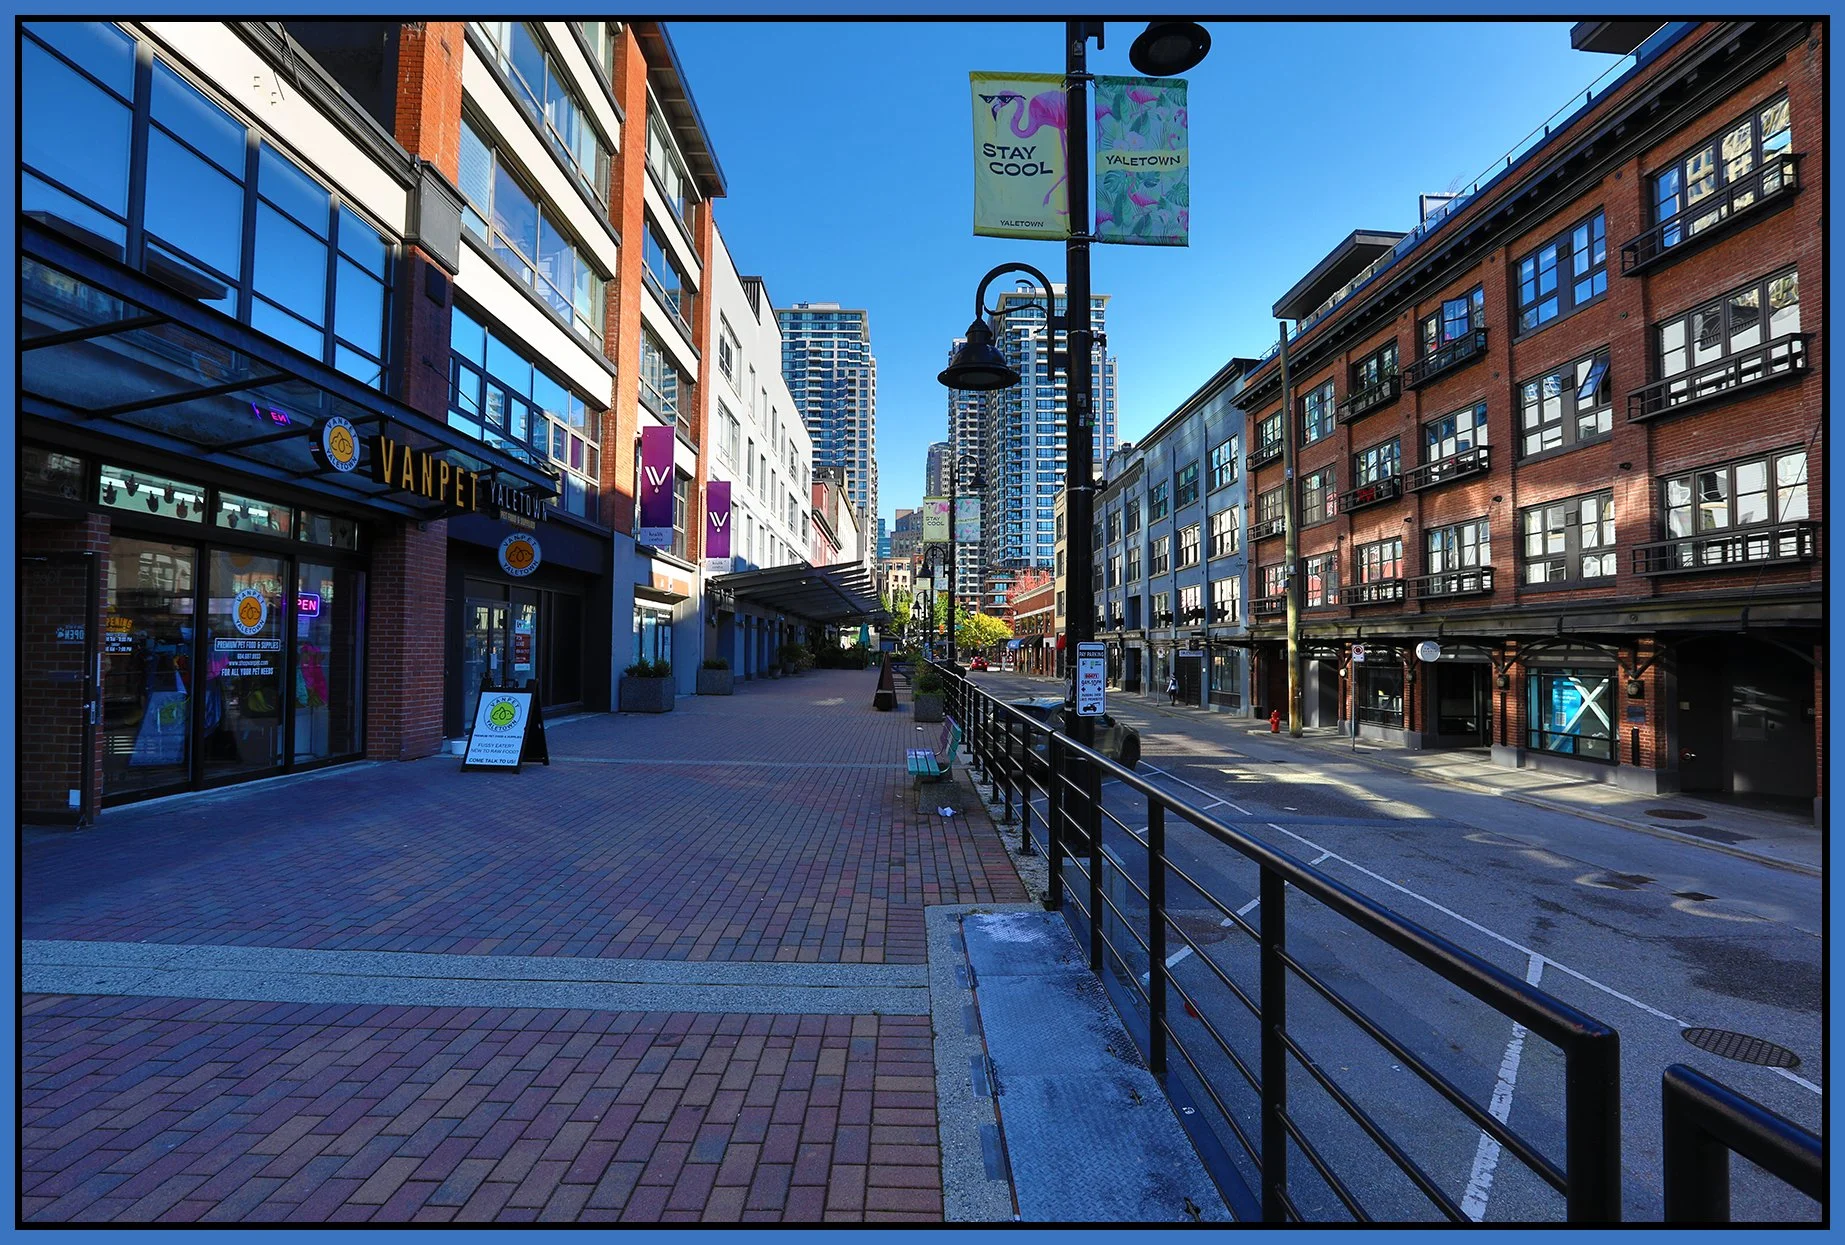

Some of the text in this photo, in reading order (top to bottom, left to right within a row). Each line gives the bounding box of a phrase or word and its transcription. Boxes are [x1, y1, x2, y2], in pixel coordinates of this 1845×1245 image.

[982, 142, 1037, 159] STAY
[1105, 155, 1181, 166] YALETOWN
[989, 161, 1054, 176] COOL
[1000, 219, 1044, 228] YALETOWN
[326, 417, 357, 439] VANPET
[326, 449, 357, 470] YALETOWN
[380, 435, 480, 512] VANPET
[489, 478, 548, 522] YALETOWN
[503, 535, 537, 547] VANPET
[503, 560, 539, 575] YALETOWN
[237, 590, 265, 605] VANPET
[297, 599, 317, 610] PEN
[105, 616, 133, 629] PENING
[235, 619, 265, 634] YALETOWN
[237, 640, 245, 649] PET
[246, 641, 257, 649] FOOD
[261, 641, 279, 649] SUPPLIES
[221, 667, 274, 676] FOR ALL YOUR PET NEEDS
[490, 697, 520, 708] VANPET
[486, 719, 517, 731] YALETOWN
